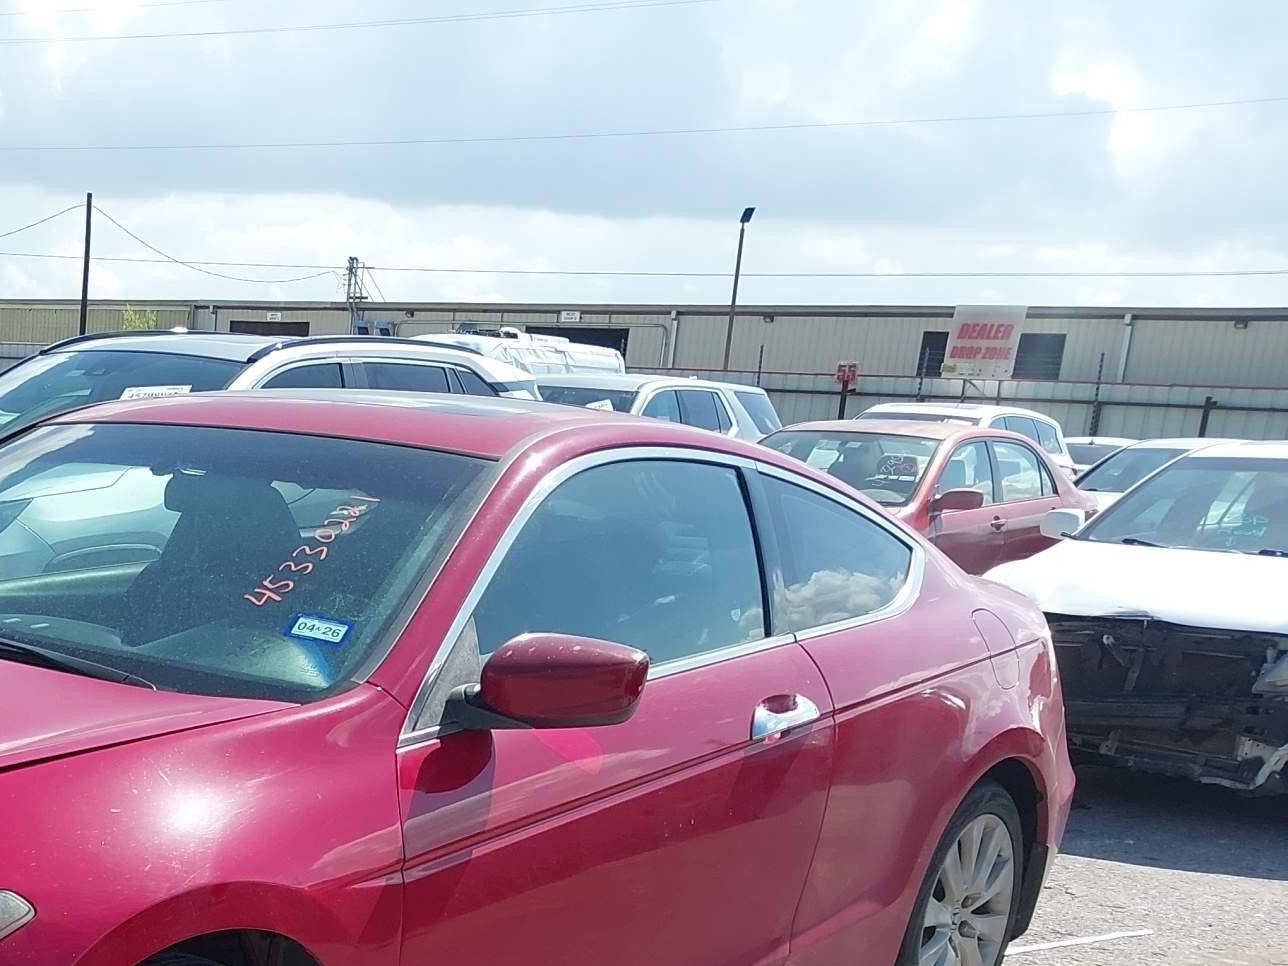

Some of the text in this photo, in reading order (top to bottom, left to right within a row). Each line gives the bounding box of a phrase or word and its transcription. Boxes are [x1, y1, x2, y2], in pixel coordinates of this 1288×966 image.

[957, 323, 1015, 340] DEALER
[949, 346, 1013, 360] DROP ZONE
[243, 495, 381, 606] 45330221
[297, 621, 342, 638] 04 26
